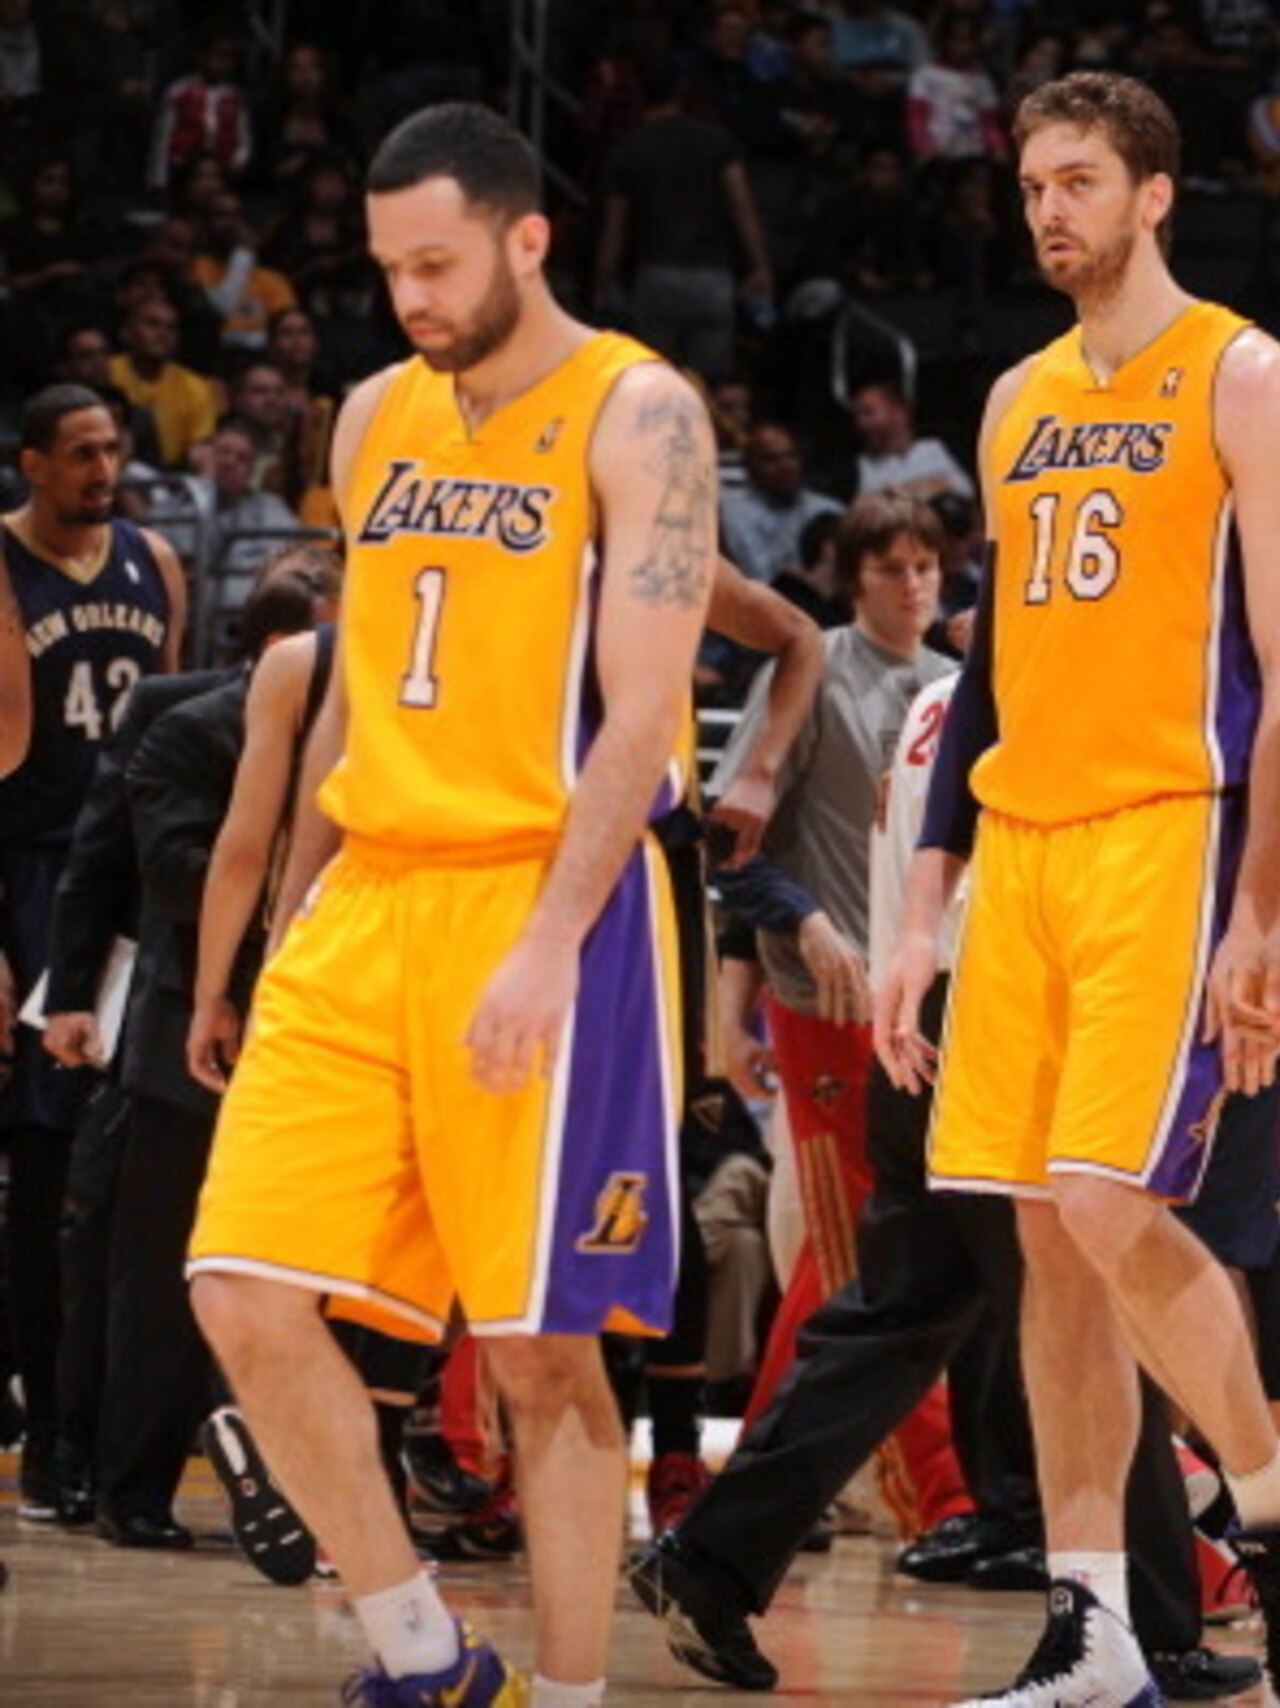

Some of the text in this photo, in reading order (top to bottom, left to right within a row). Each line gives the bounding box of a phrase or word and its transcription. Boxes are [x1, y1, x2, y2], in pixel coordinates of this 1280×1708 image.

[1003, 414, 1175, 484] LAKERS
[355, 460, 558, 555] LAKERS
[1024, 488, 1123, 606] 16
[72, 603, 165, 647] ORLEANS
[398, 564, 447, 709] 1
[64, 657, 142, 741] 42
